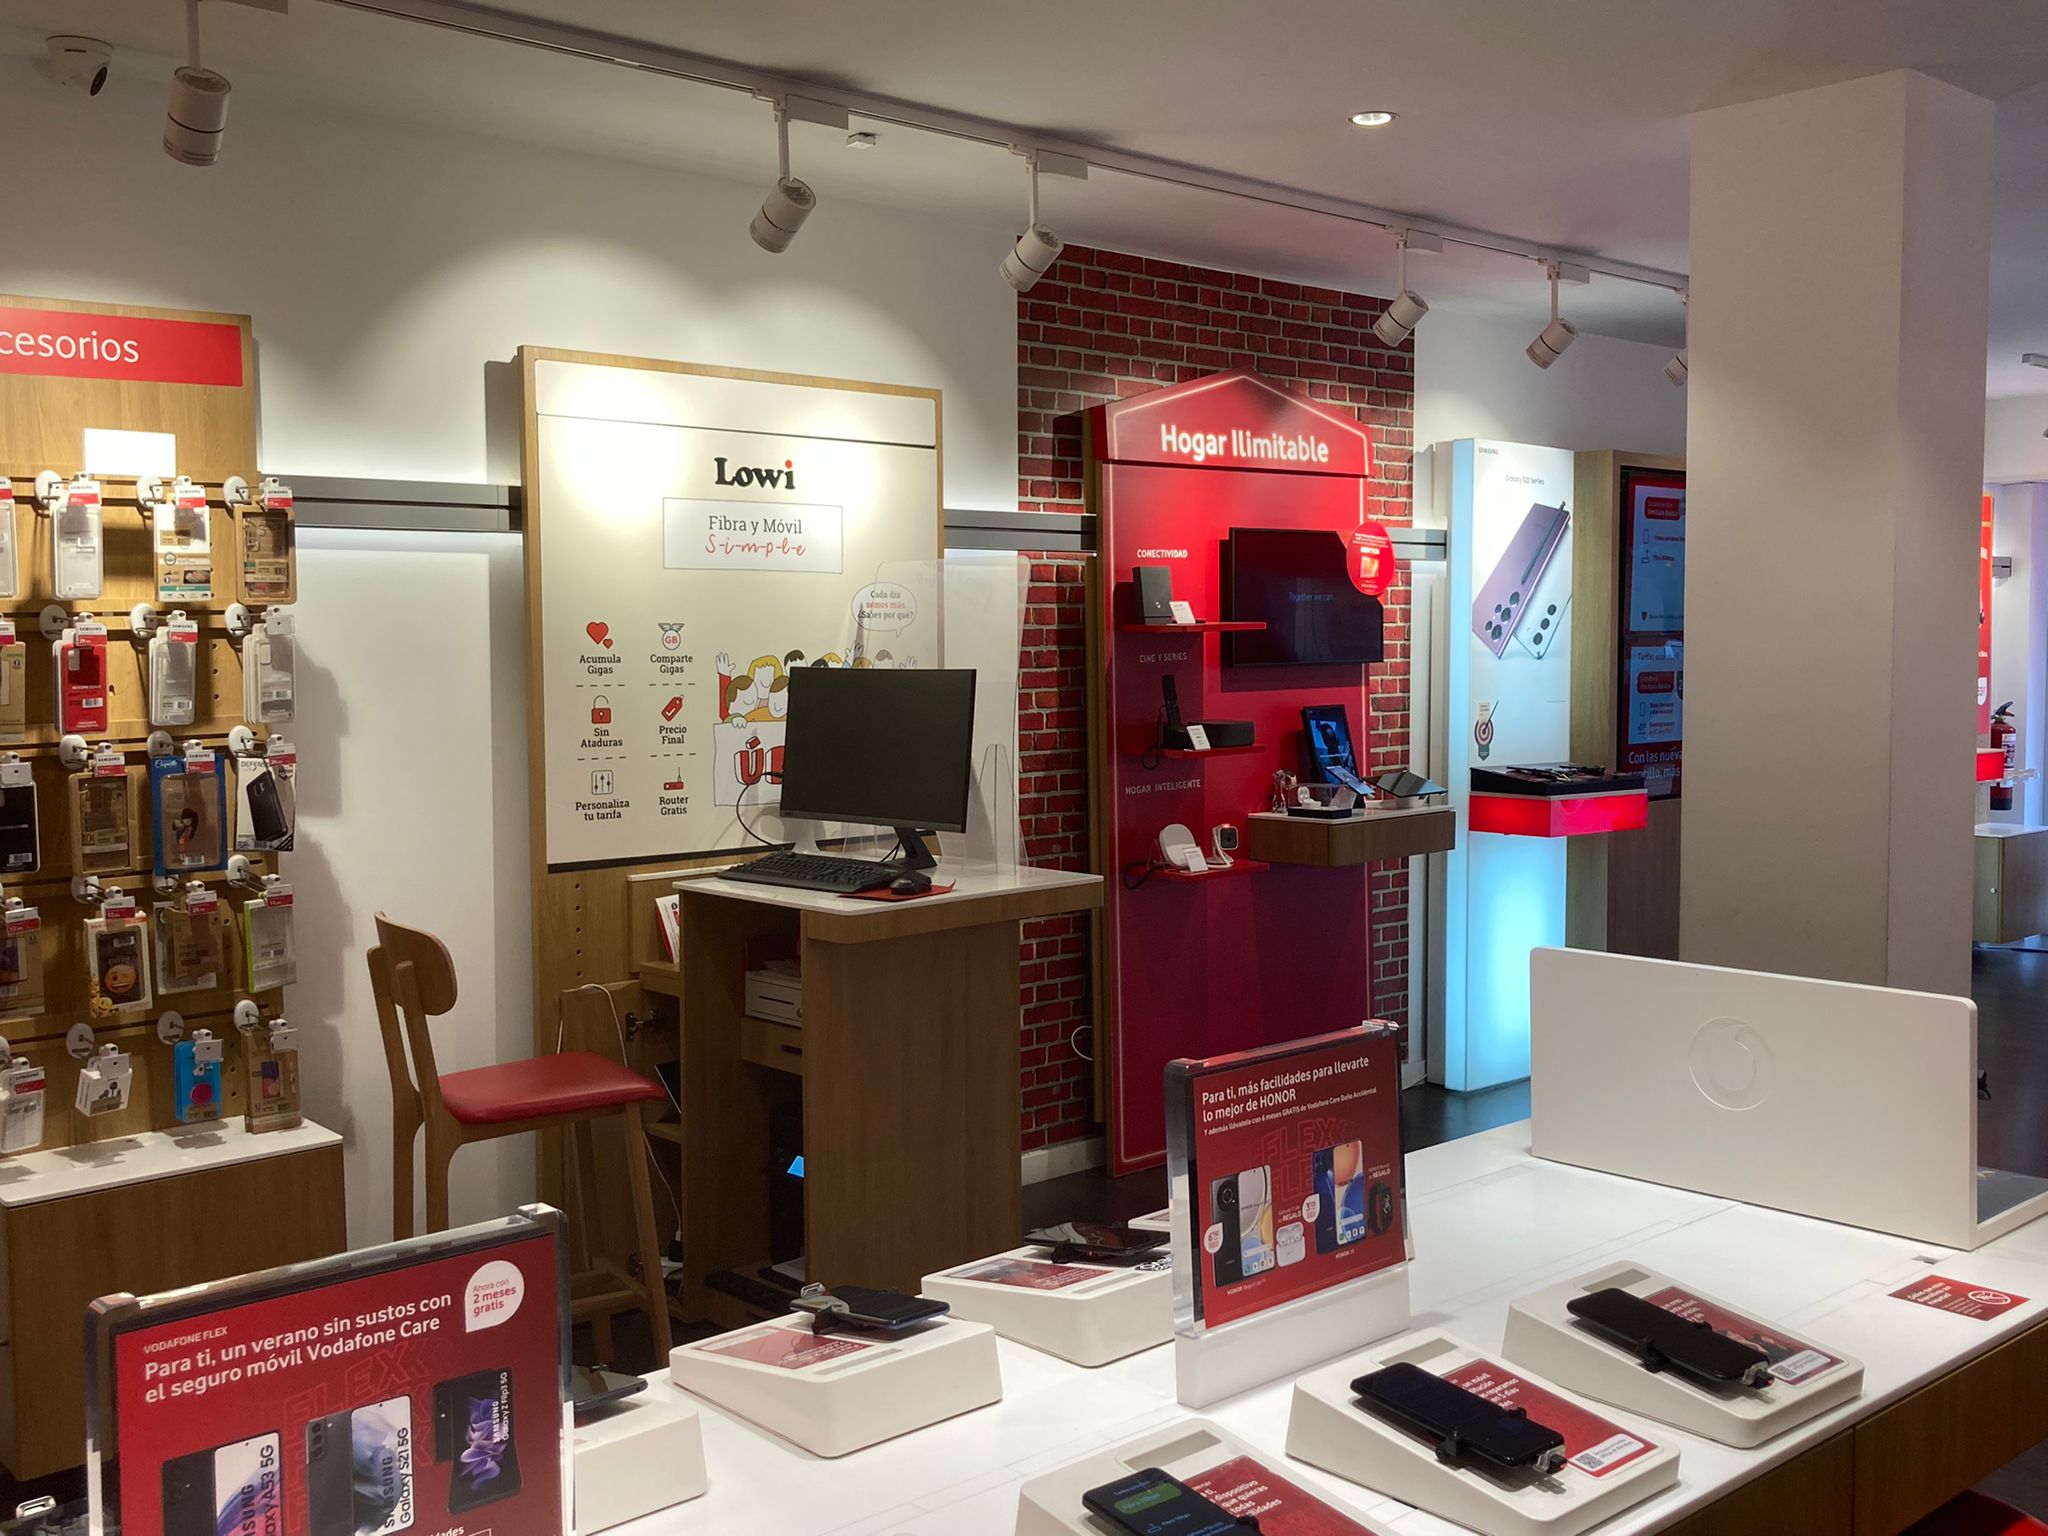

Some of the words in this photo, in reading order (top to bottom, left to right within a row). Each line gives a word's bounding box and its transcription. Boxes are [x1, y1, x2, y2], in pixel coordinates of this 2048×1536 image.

[1160, 423, 1227, 462] Hogar
[1231, 429, 1330, 463] Ilimitable
[713, 456, 796, 491] Lowi
[708, 514, 748, 534] Fibra
[750, 519, 759, 536] y
[762, 516, 803, 535] Móvil
[1135, 548, 1189, 559] CONECTIVIDAD
[664, 635, 679, 645] GB
[579, 653, 622, 665] Acumula
[649, 653, 694, 667] Comparte
[587, 665, 614, 677] Gigas
[659, 664, 685, 676] Gigas
[593, 727, 610, 738] Sin
[659, 725, 687, 735] Precio
[580, 737, 623, 749] Ataduras
[661, 735, 685, 745] Final
[1125, 783, 1152, 795] HOGAR
[1154, 778, 1201, 793] INTELIGENTE
[575, 799, 630, 811] Personaliza
[659, 795, 689, 806] Router
[584, 812, 594, 821] tu
[596, 810, 622, 821] tarifa
[660, 805, 688, 816] Gratis
[1202, 1091, 1225, 1105] Para
[1226, 1088, 1237, 1100] ti,
[1238, 1081, 1259, 1098] más
[1260, 1071, 1311, 1092] facilidades
[1313, 1065, 1333, 1082] para
[1334, 1056, 1369, 1074] llevarte
[1202, 1109, 1214, 1123] lo
[1215, 1103, 1244, 1120] mejor
[1245, 1098, 1258, 1111] de
[1259, 1088, 1297, 1109] HONOR
[1282, 1106, 1300, 1119] GRATIS
[472, 1281, 495, 1294] Ahora
[495, 1278, 510, 1288] con
[473, 1293, 481, 1304] 2
[481, 1285, 517, 1302] meses
[473, 1300, 505, 1318] gratis
[143, 1333, 202, 1355] VODAFONE
[203, 1326, 228, 1340] FLEX
[145, 1357, 192, 1381] Para
[196, 1349, 216, 1368] ti,
[220, 1344, 247, 1362] un
[251, 1325, 319, 1353] verano
[323, 1316, 351, 1336] sin
[355, 1302, 416, 1328] sustos
[420, 1293, 452, 1313] con
[145, 1383, 166, 1404] el
[171, 1366, 242, 1398] seguro
[247, 1346, 303, 1378] móvil
[306, 1323, 401, 1362] Vodafone
[400, 1317, 441, 1338] Care
[397, 1427, 409, 1448] 5G
[260, 1444, 275, 1469] 5G
[399, 1449, 410, 1472] S21
[261, 1471, 276, 1501] A53
[1213, 1480, 1258, 1500] dispositivo
[400, 1472, 414, 1524] Galaxy
